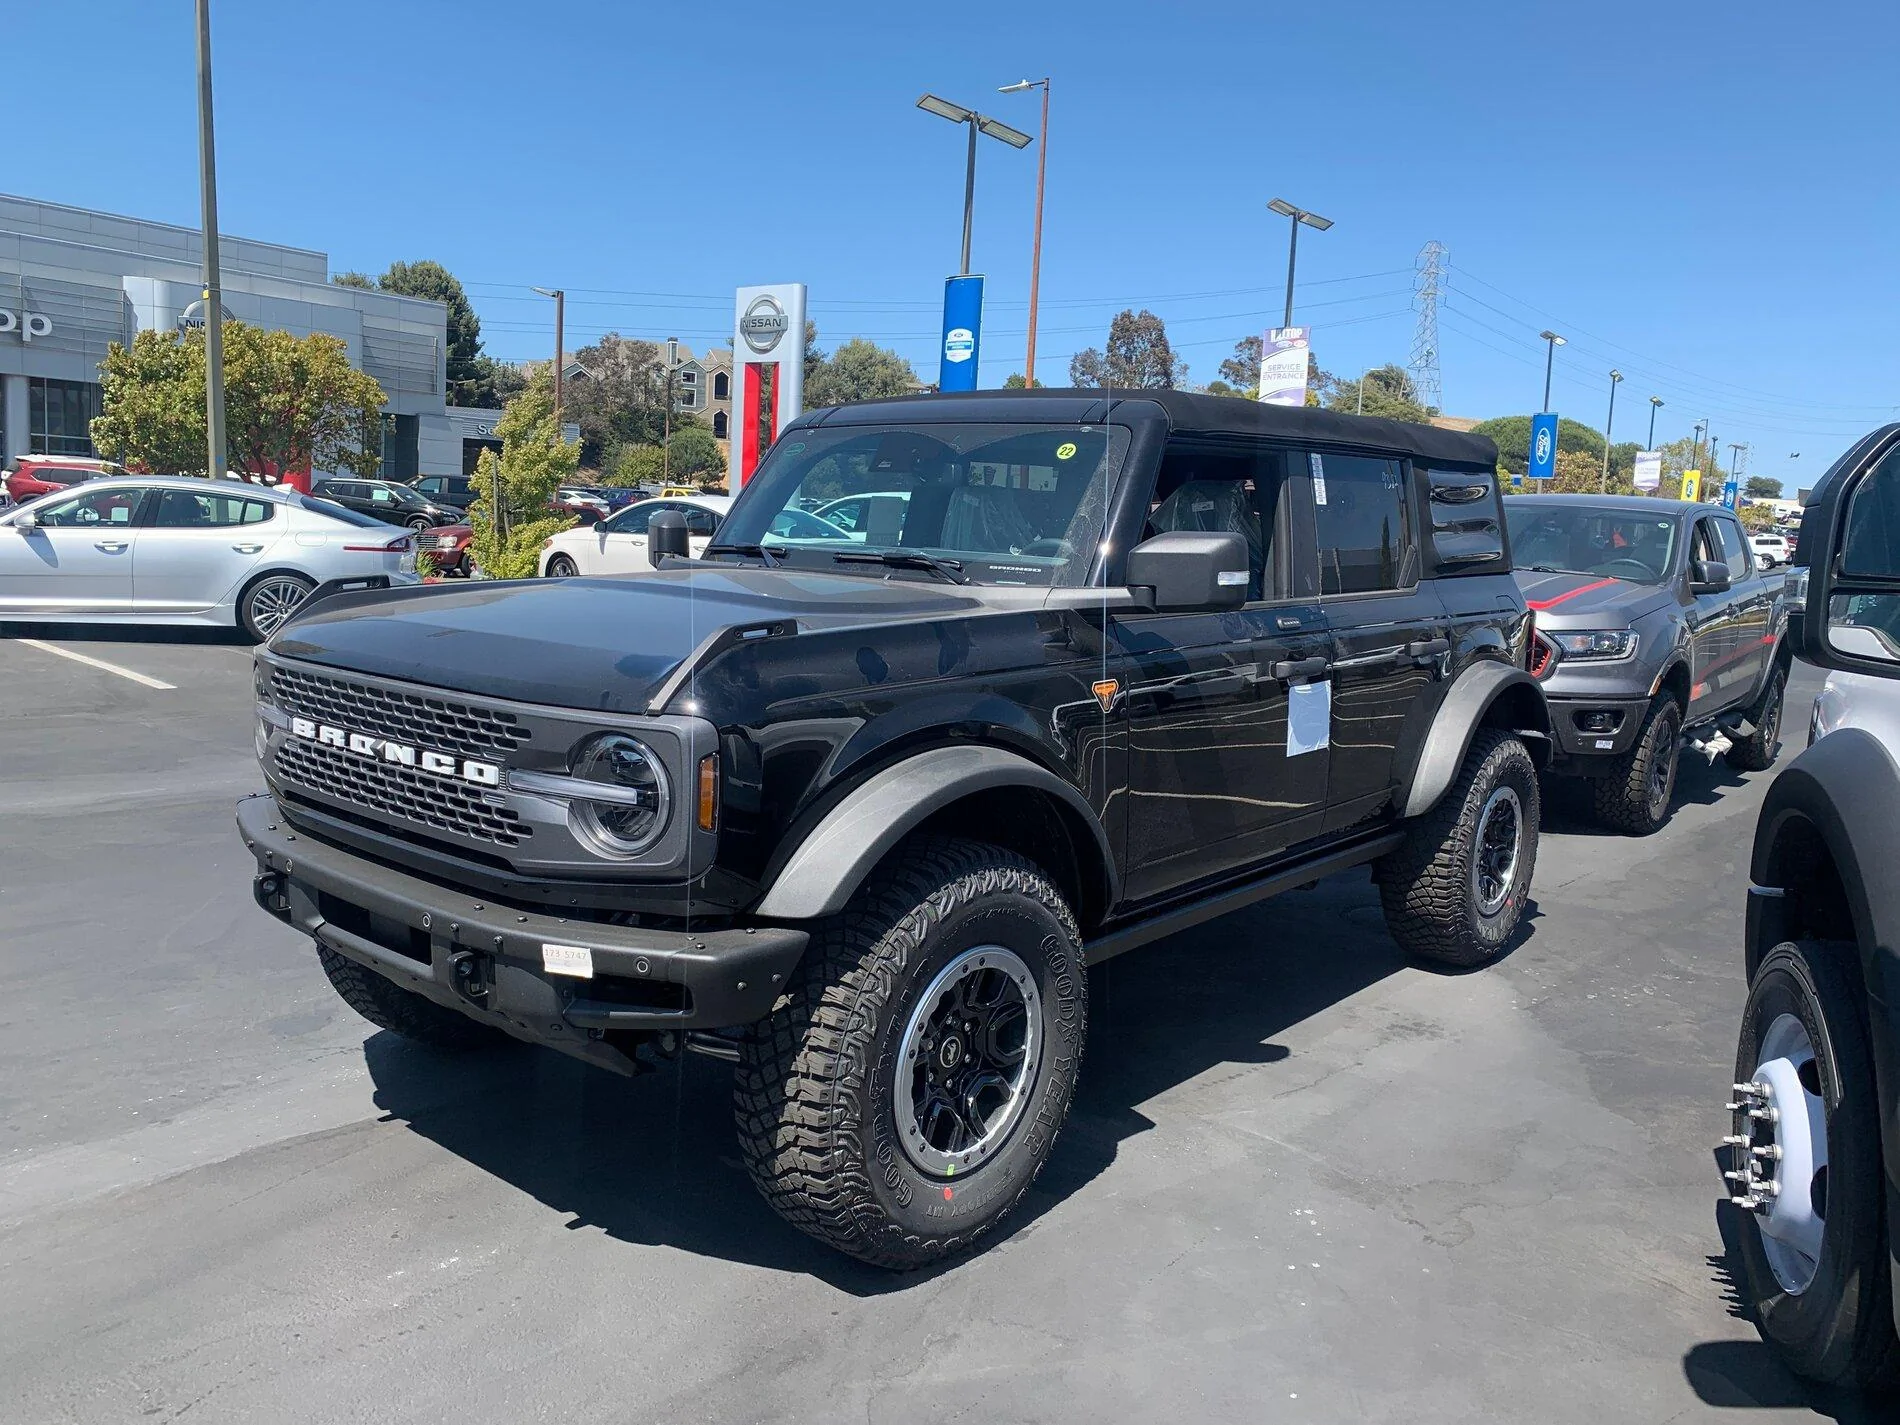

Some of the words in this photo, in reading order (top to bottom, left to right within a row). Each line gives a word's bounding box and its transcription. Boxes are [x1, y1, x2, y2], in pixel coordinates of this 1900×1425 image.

[743, 318, 782, 328] NISSAN
[1267, 363, 1301, 371] SERVICE
[1262, 372, 1306, 381] ENTRANCE
[1059, 446, 1074, 456] 22
[291, 716, 500, 786] BRONCO
